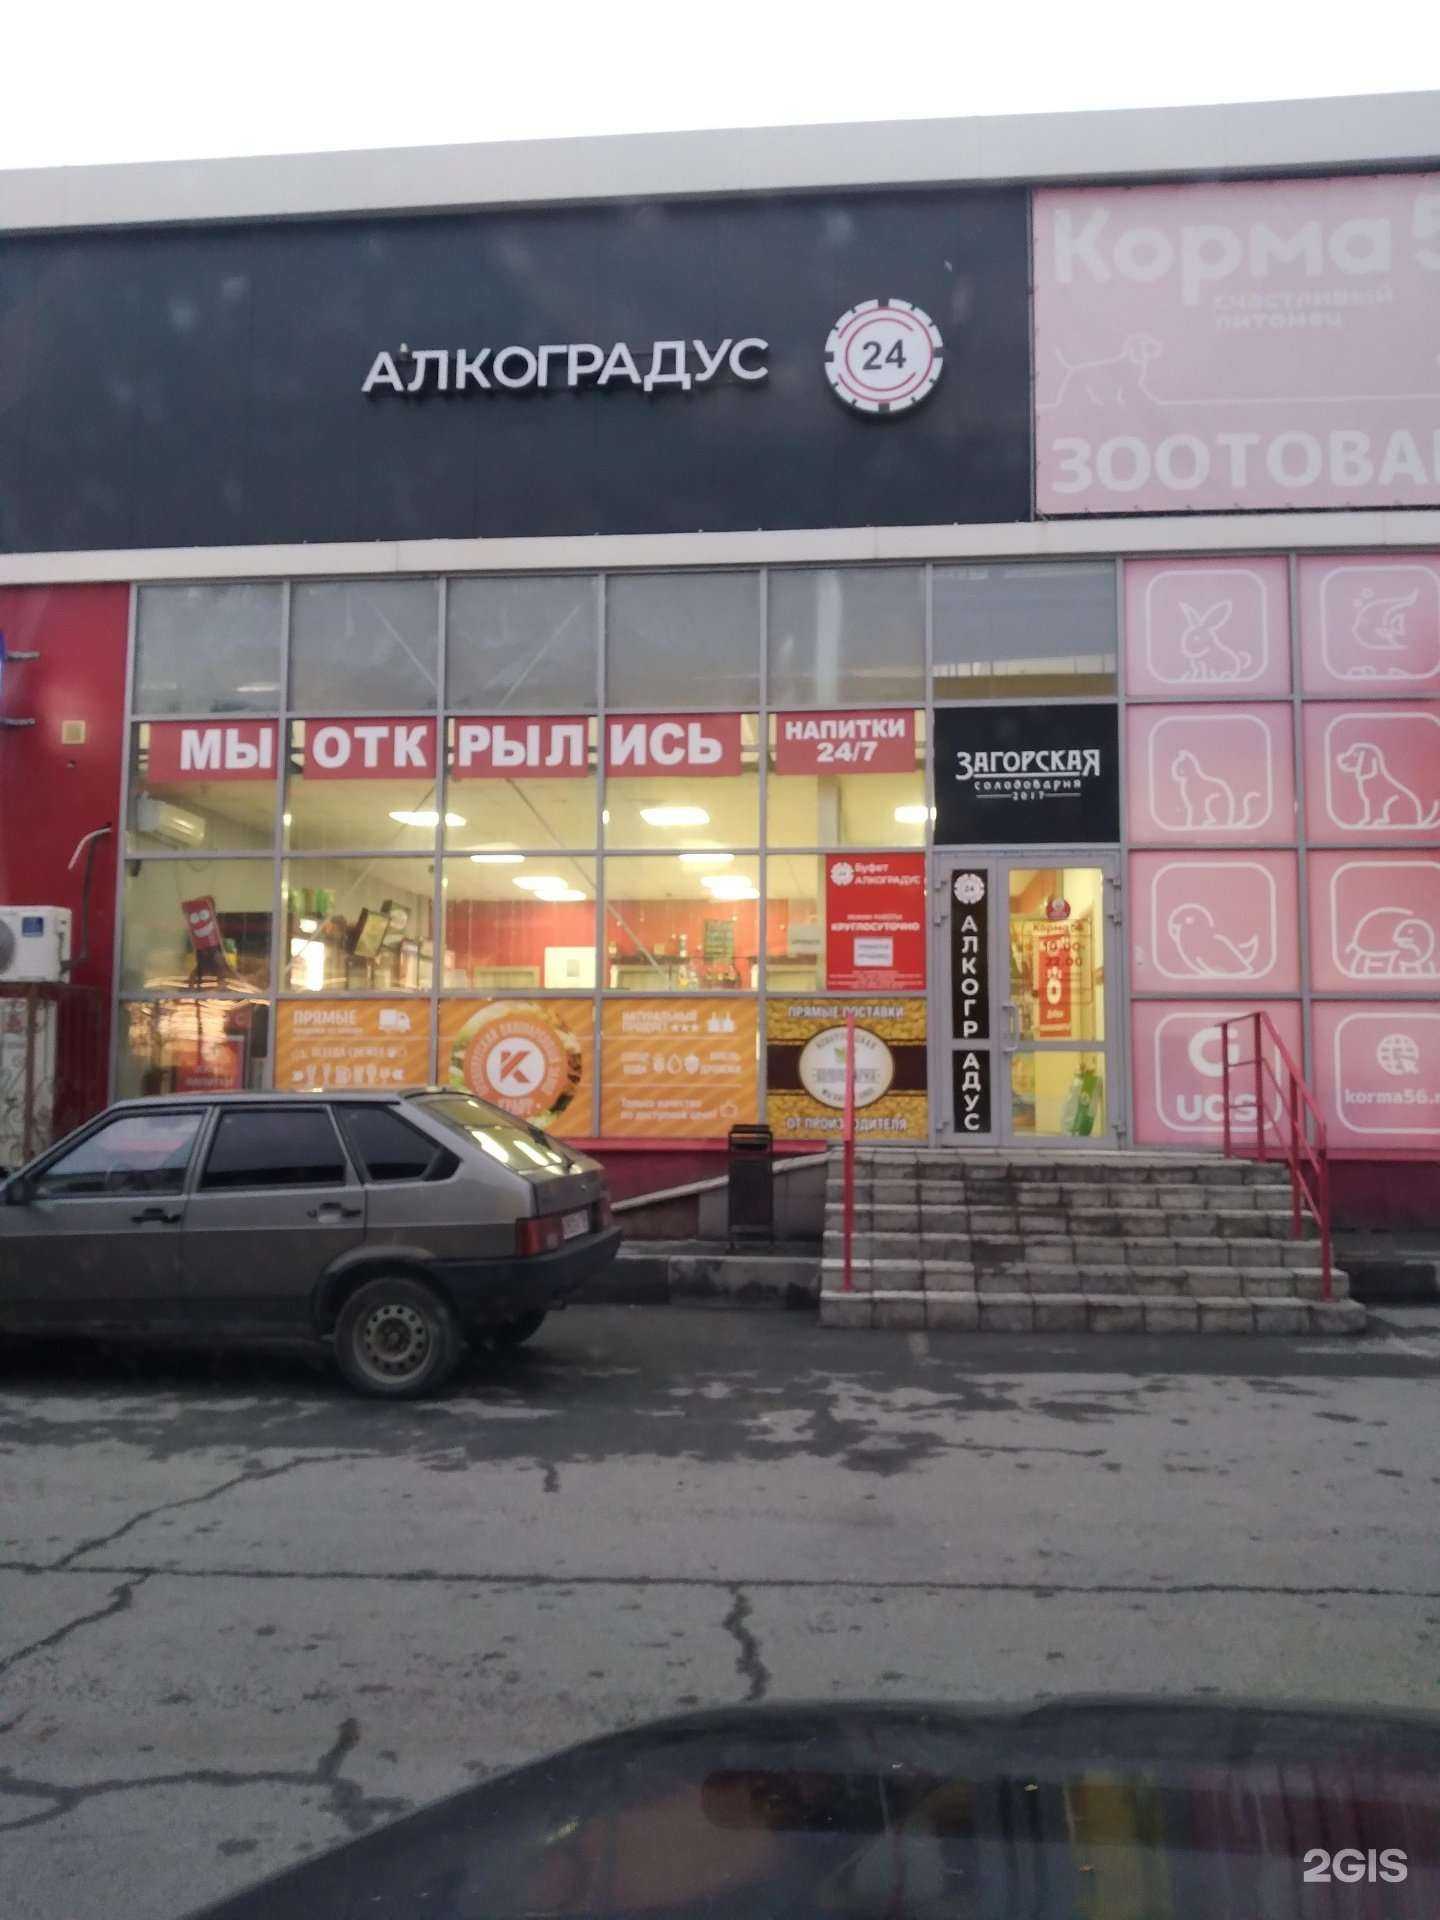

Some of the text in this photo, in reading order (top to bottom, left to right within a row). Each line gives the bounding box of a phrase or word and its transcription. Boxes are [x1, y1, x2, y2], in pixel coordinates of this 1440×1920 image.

[1053, 205, 1392, 305] Корма
[361, 337, 769, 393] АЛКОГРАДУС
[861, 339, 908, 371] 24
[1051, 428, 1440, 494] ЗООТОВА
[784, 718, 906, 741] НАПИТКИ
[180, 726, 274, 771] МЫ
[816, 741, 879, 763] 24/7
[955, 749, 1101, 781] ЗАГОРСКАЯ
[293, 1009, 358, 1026] ПРЯМЫЕ
[788, 1006, 838, 1018] ПРЯМЫЕ
[804, 1116, 908, 1131] ПРОИЗОДИТЕЛЯ
